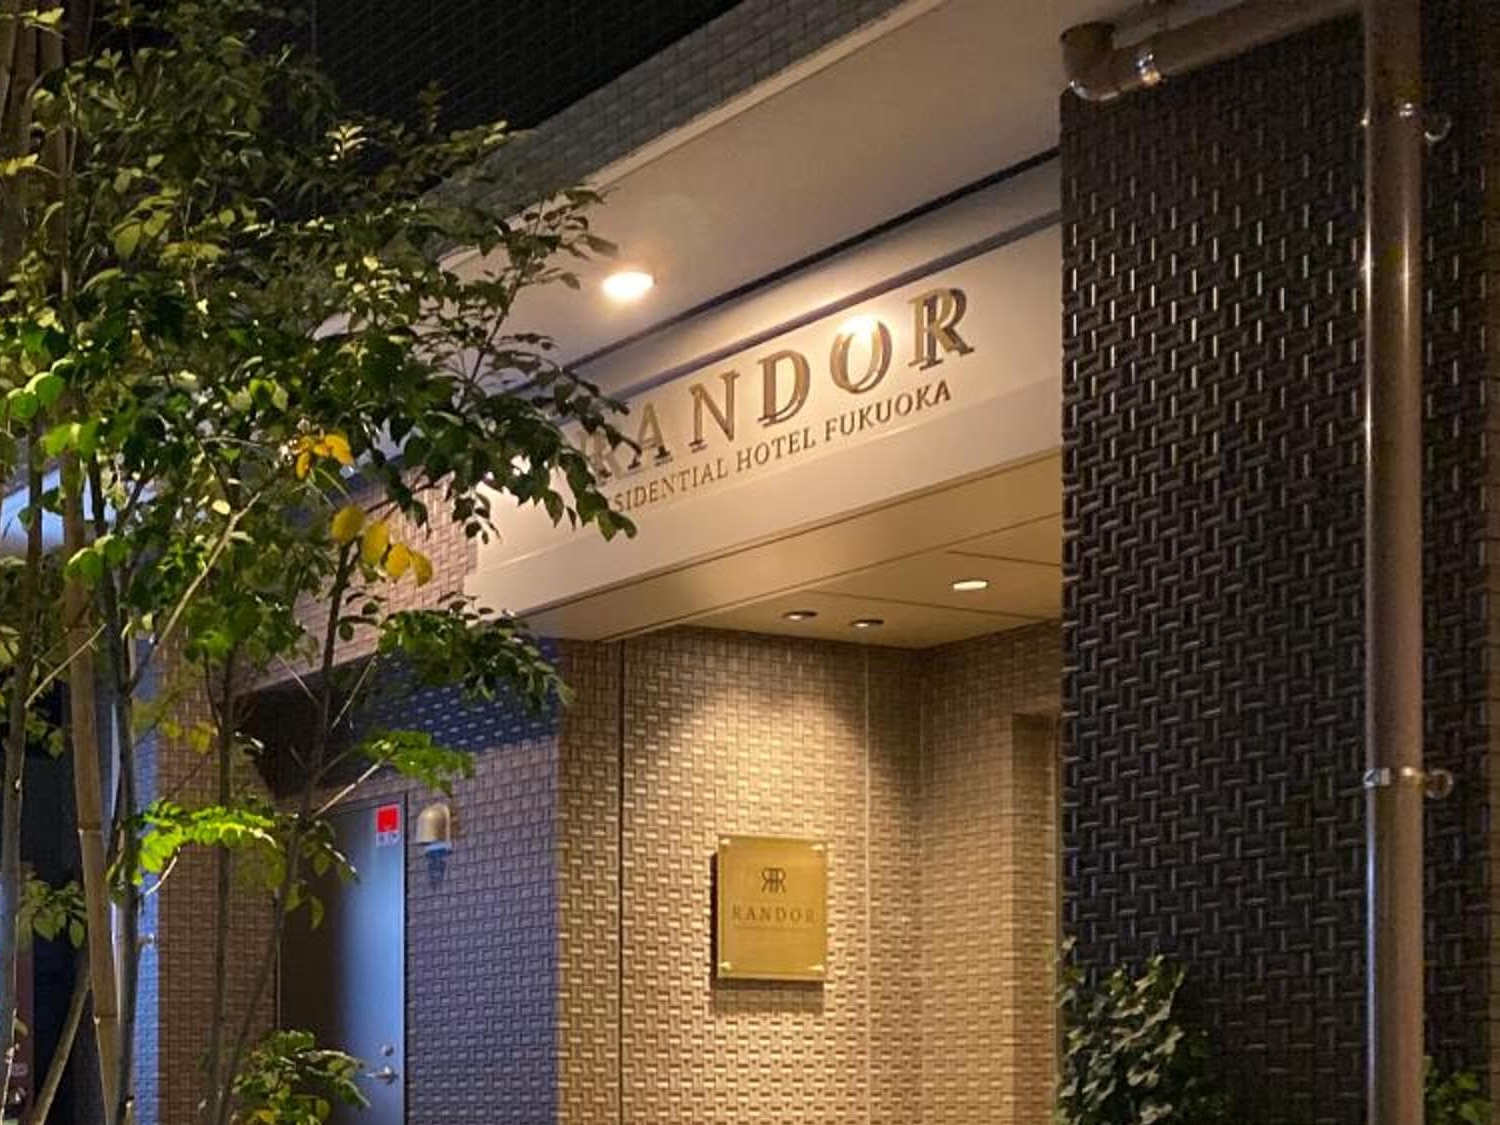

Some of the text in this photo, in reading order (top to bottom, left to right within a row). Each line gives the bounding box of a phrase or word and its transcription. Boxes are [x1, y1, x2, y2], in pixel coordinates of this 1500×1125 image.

[582, 287, 975, 487] RANDOR
[610, 378, 952, 513] SIDENTIAL HOTEL FUKUOKA
[732, 903, 818, 923] RANDOR
